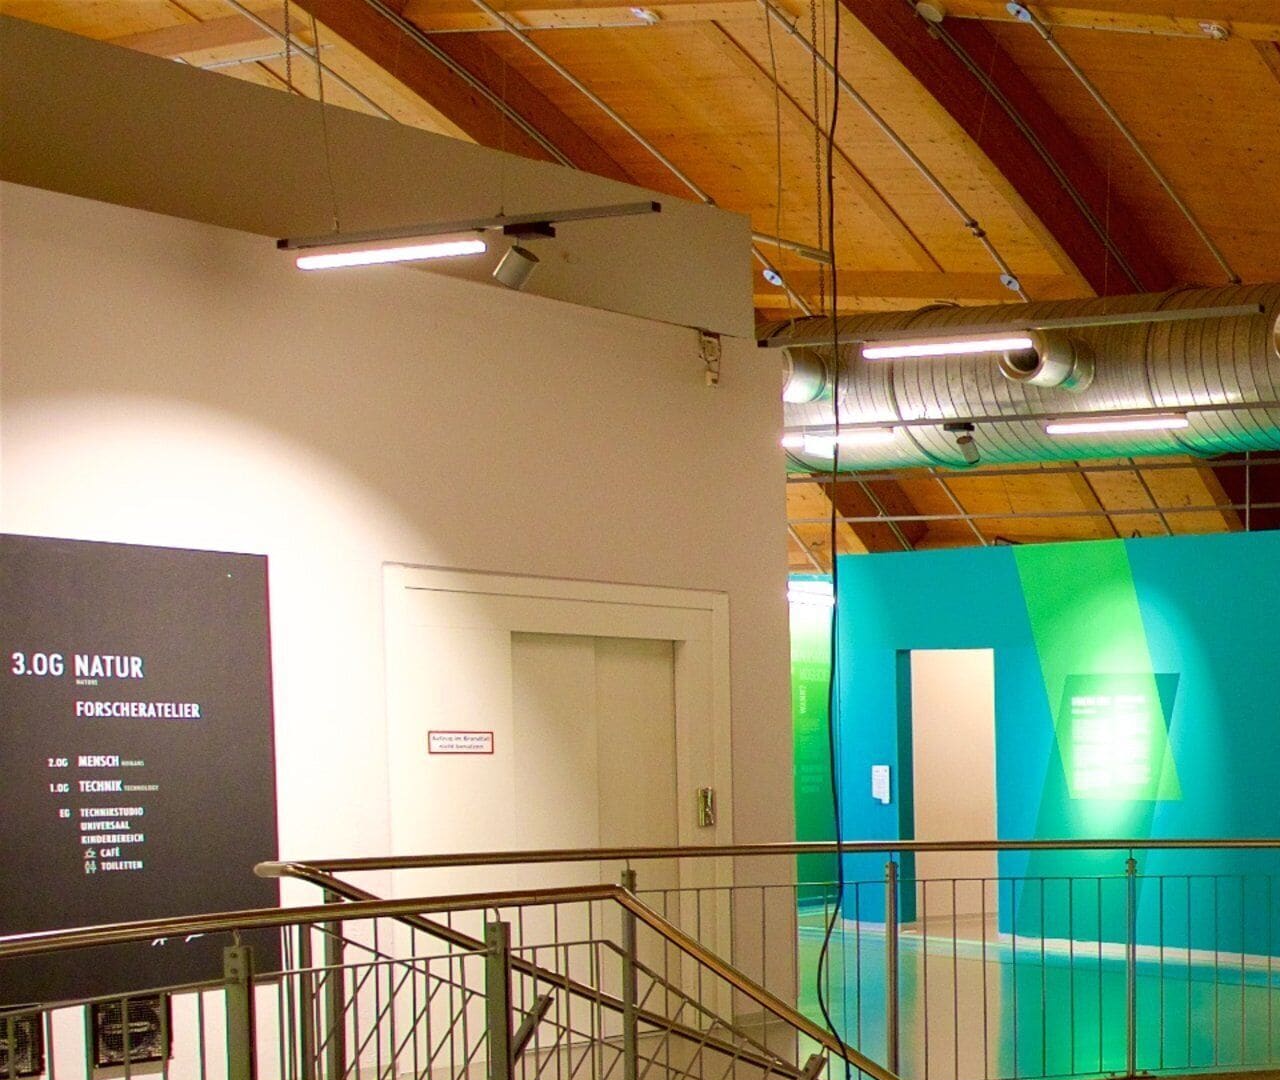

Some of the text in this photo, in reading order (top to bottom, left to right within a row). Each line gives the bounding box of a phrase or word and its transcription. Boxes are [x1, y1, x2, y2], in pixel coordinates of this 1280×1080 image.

[11, 652, 144, 679] 3.OG NATUR
[75, 701, 200, 719] FORSCHERATELIER
[48, 758, 69, 768] 2.OG
[78, 755, 119, 768] MENSCH
[50, 783, 70, 793] 1.OG
[79, 780, 122, 792] TECHNIK
[59, 807, 144, 818] EG TECHNIKSTUDIO
[101, 861, 144, 871] TOILETTEN
